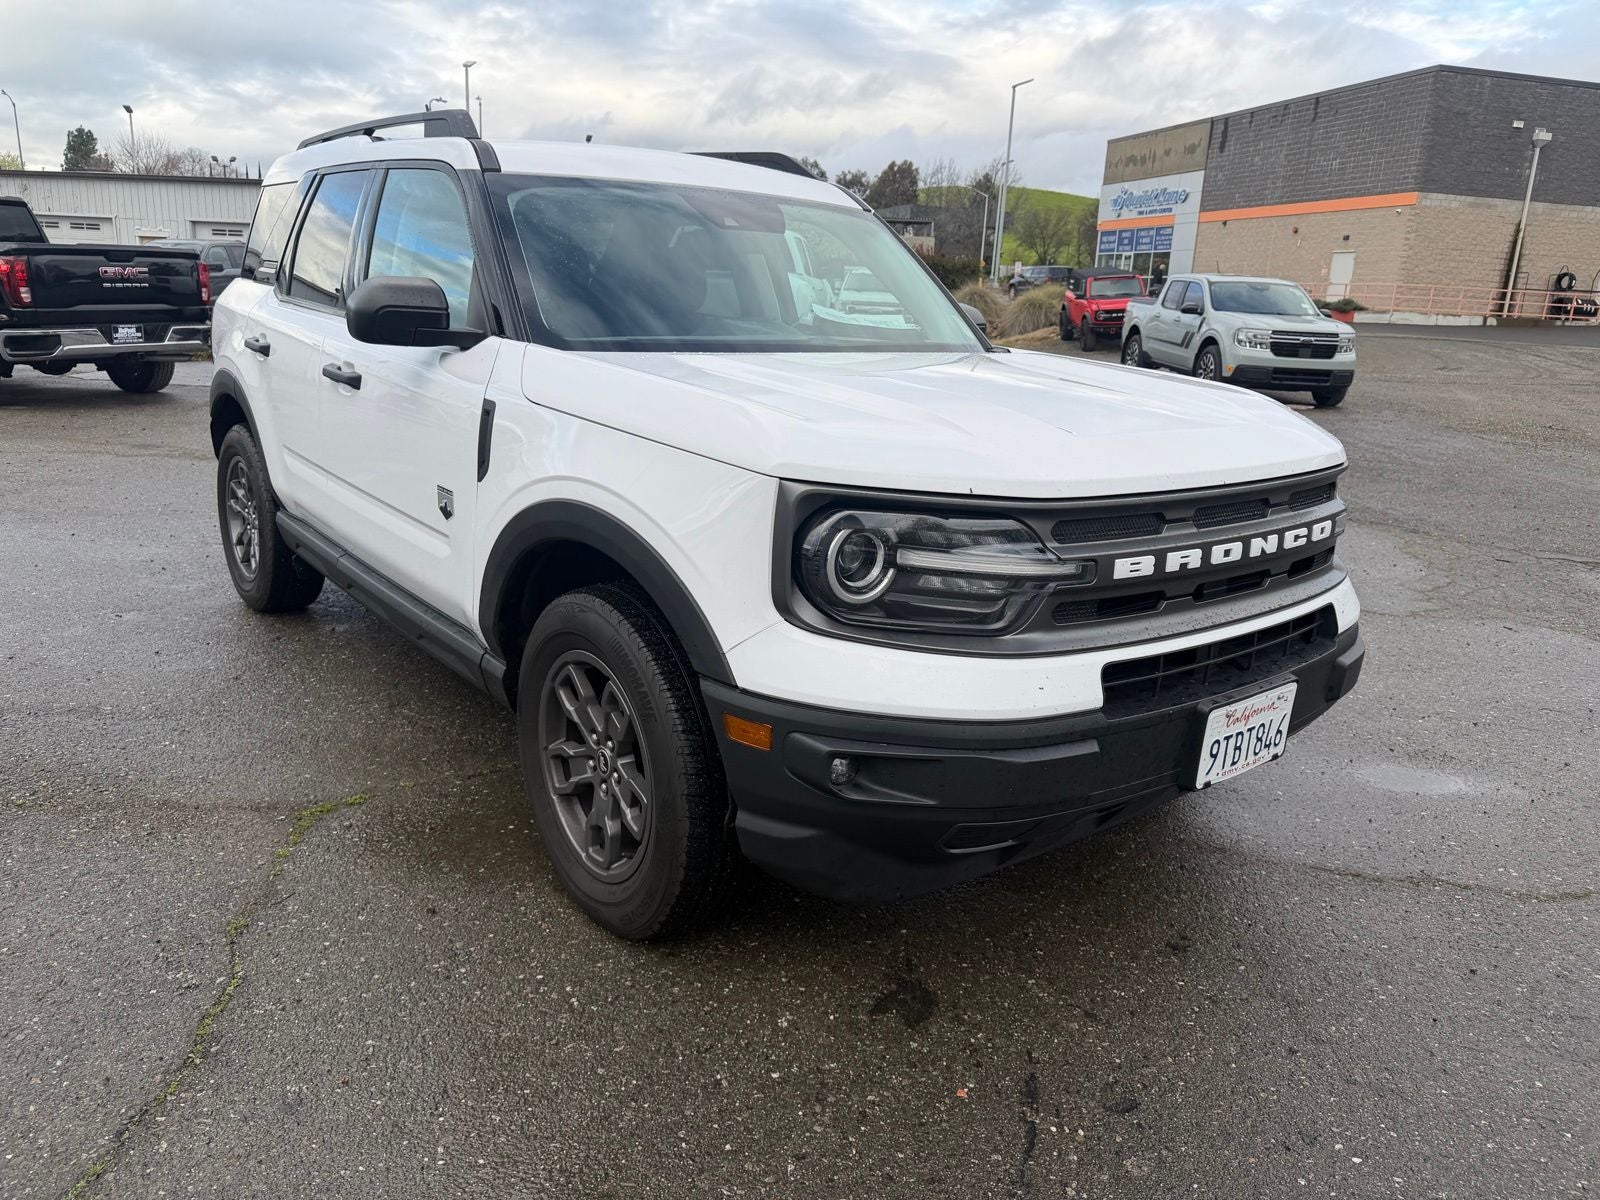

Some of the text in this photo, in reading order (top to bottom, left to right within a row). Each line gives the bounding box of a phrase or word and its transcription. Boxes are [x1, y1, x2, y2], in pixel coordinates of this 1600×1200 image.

[99, 266, 149, 278] GMC
[1113, 519, 1332, 580] BRONCO
[1226, 701, 1279, 728] California
[1206, 712, 1288, 776] 9TBT846
